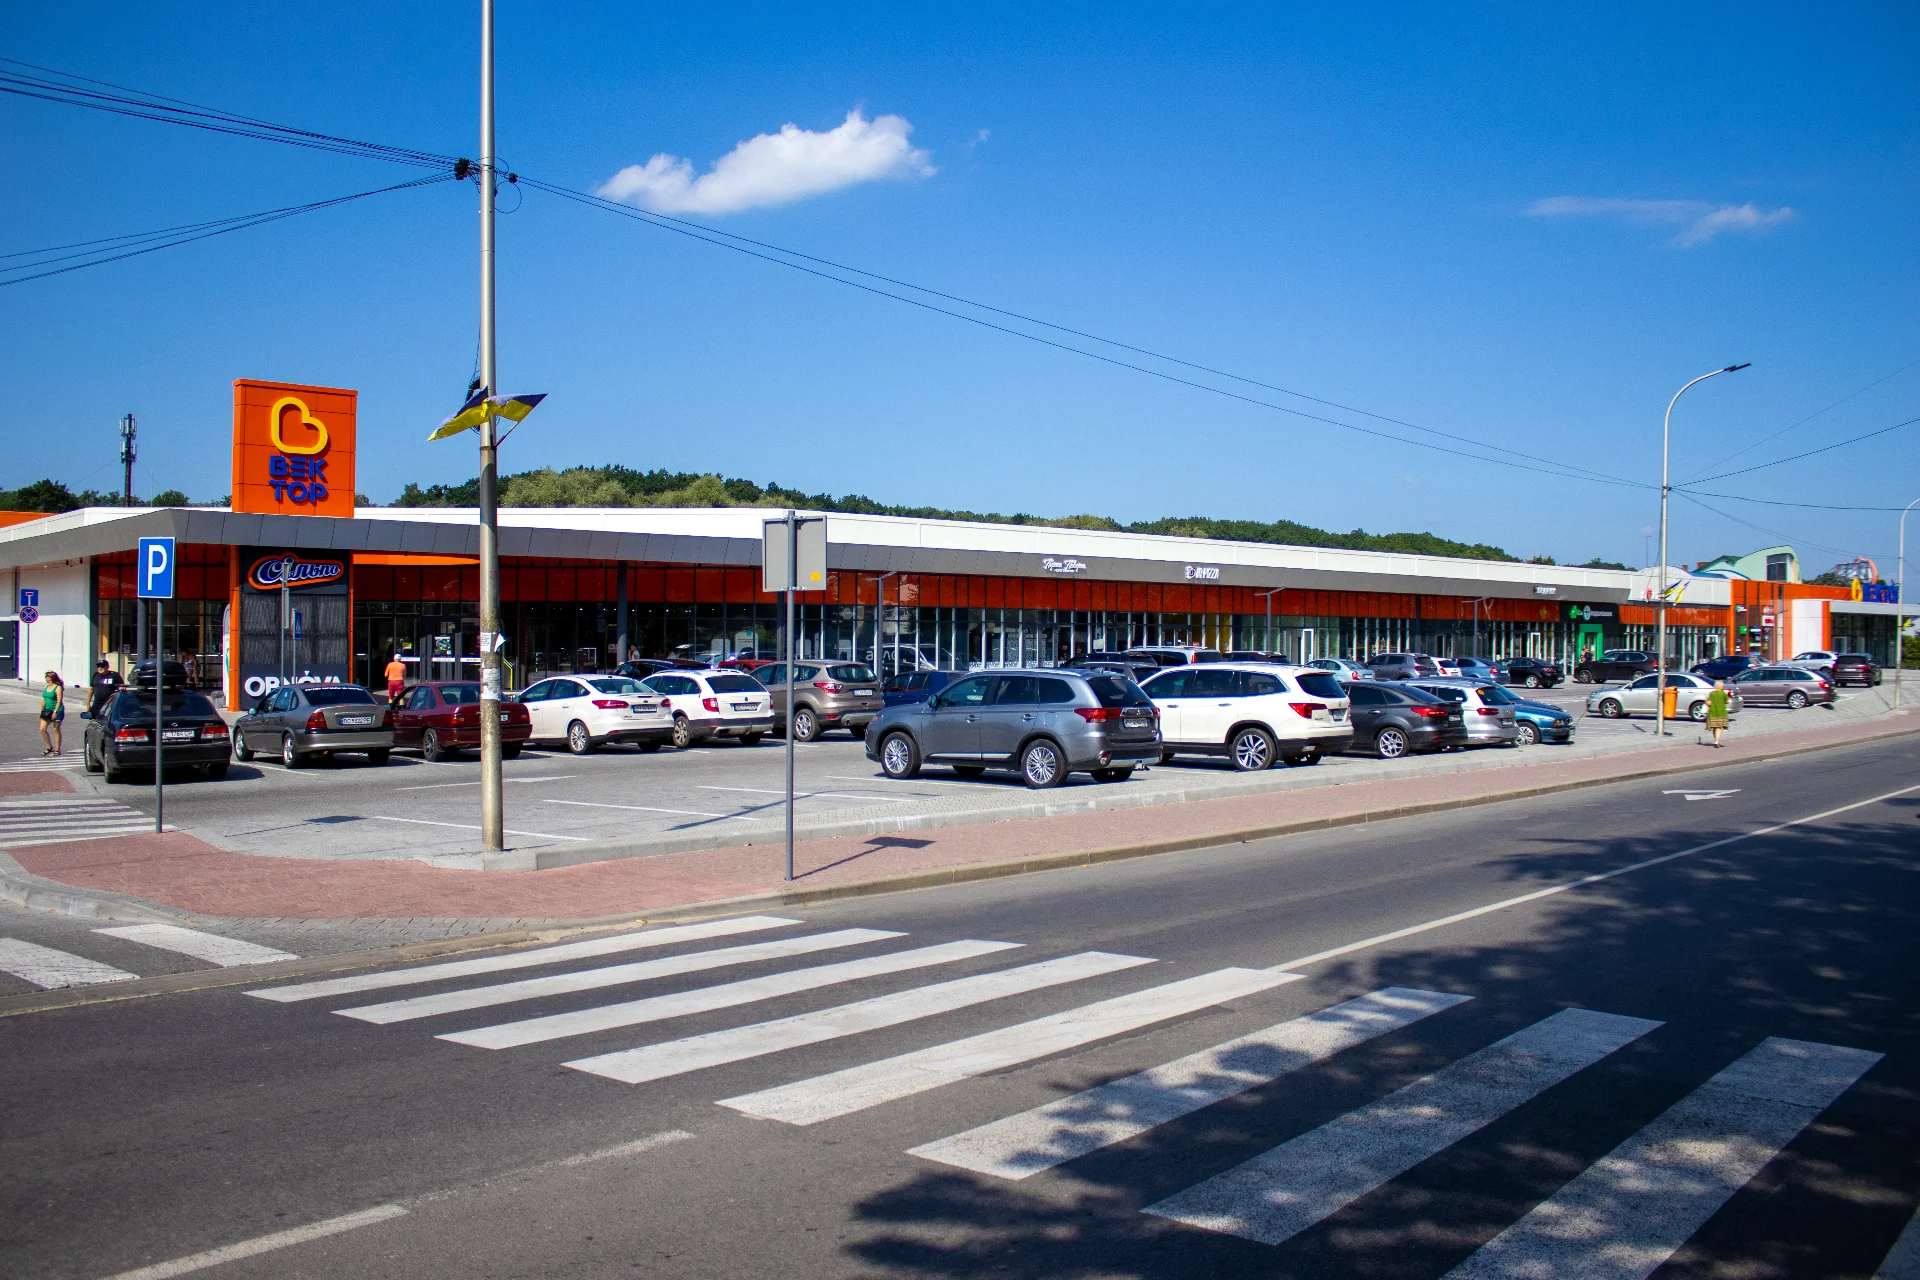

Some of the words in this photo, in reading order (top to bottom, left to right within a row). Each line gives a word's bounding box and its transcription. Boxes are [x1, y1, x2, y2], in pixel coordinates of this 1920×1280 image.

[269, 455, 327, 479] ВЕК
[268, 479, 327, 502] ТОР
[147, 544, 168, 591] P
